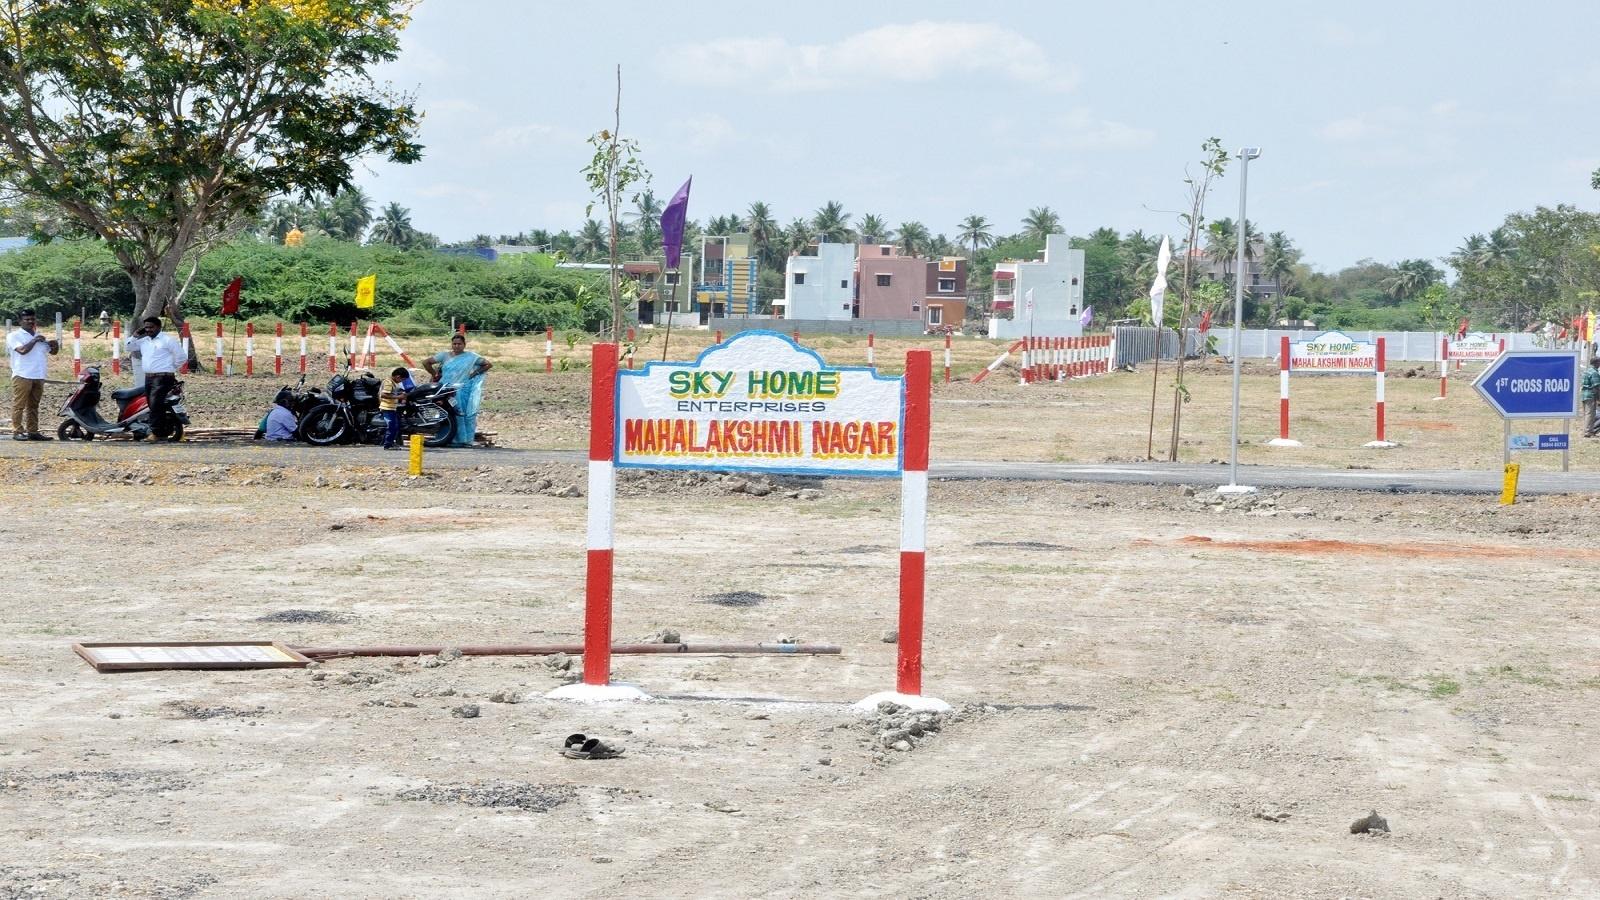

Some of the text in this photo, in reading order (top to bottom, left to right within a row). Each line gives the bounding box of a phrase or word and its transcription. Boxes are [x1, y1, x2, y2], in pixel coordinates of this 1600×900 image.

[1306, 343, 1358, 352] SKY HOME
[1292, 357, 1375, 369] MAHALAKSHMI NAGAR
[668, 370, 841, 399] SKY HOME
[1511, 379, 1542, 393] CROSS
[1544, 378, 1570, 392] ROAD
[677, 400, 827, 413] ENTERPRISES
[624, 417, 897, 460] MAHALAKSHMI NAGAR
